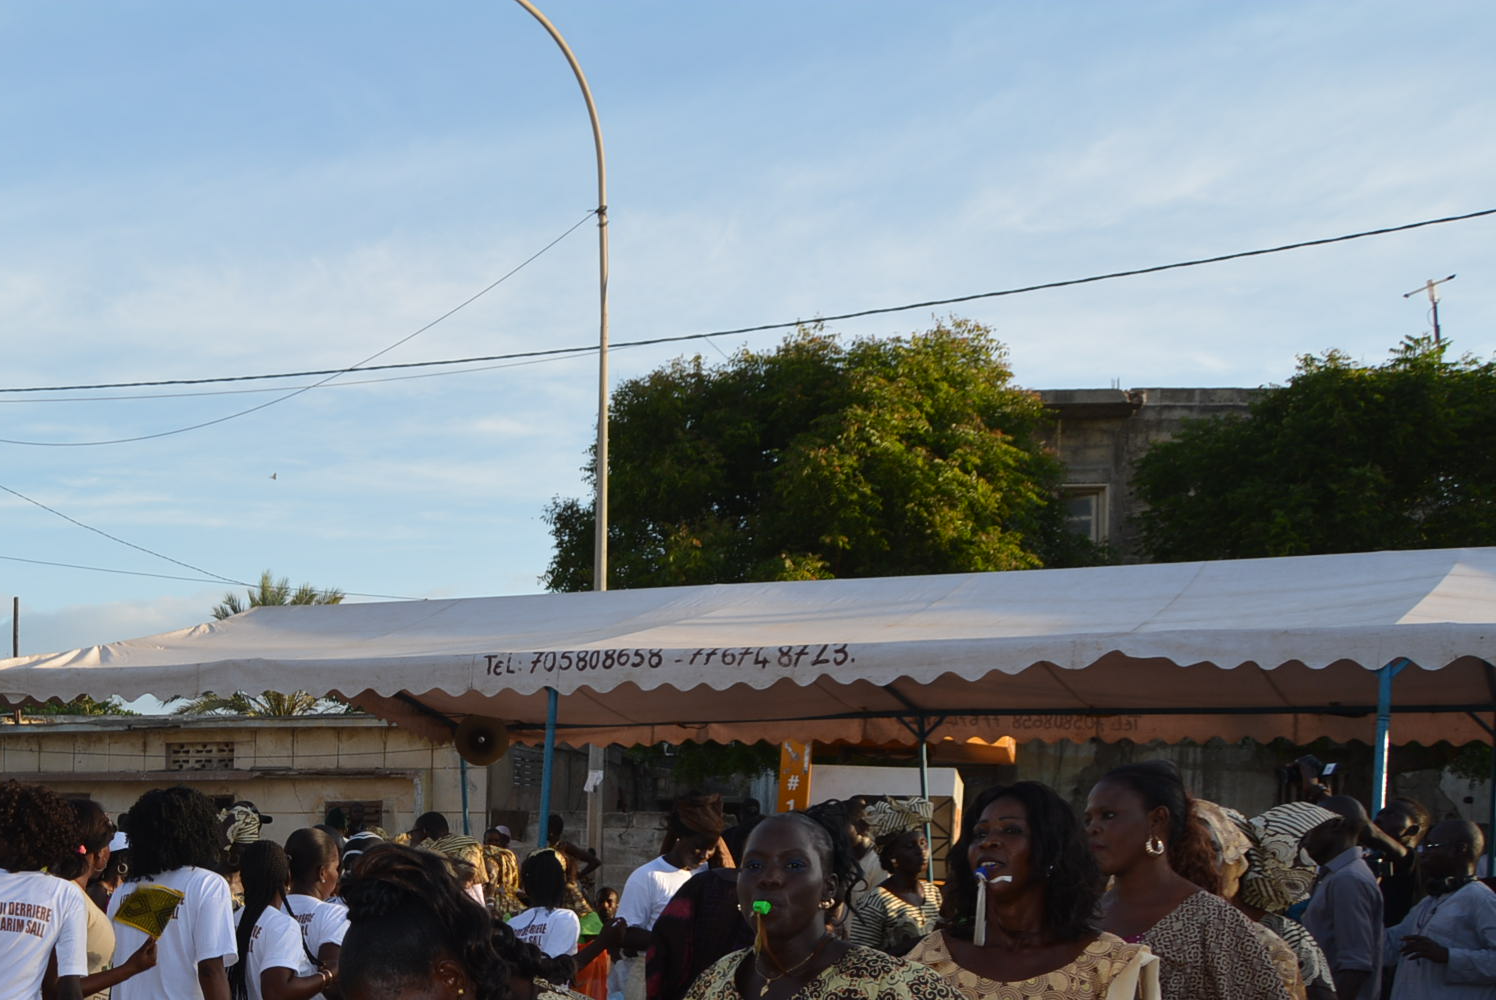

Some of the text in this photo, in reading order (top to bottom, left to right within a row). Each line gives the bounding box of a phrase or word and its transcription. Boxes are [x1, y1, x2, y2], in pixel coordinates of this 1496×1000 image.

[530, 648, 664, 674] 705808658
[8, 902, 52, 922] DERRIERE
[25, 920, 45, 938] SALL
